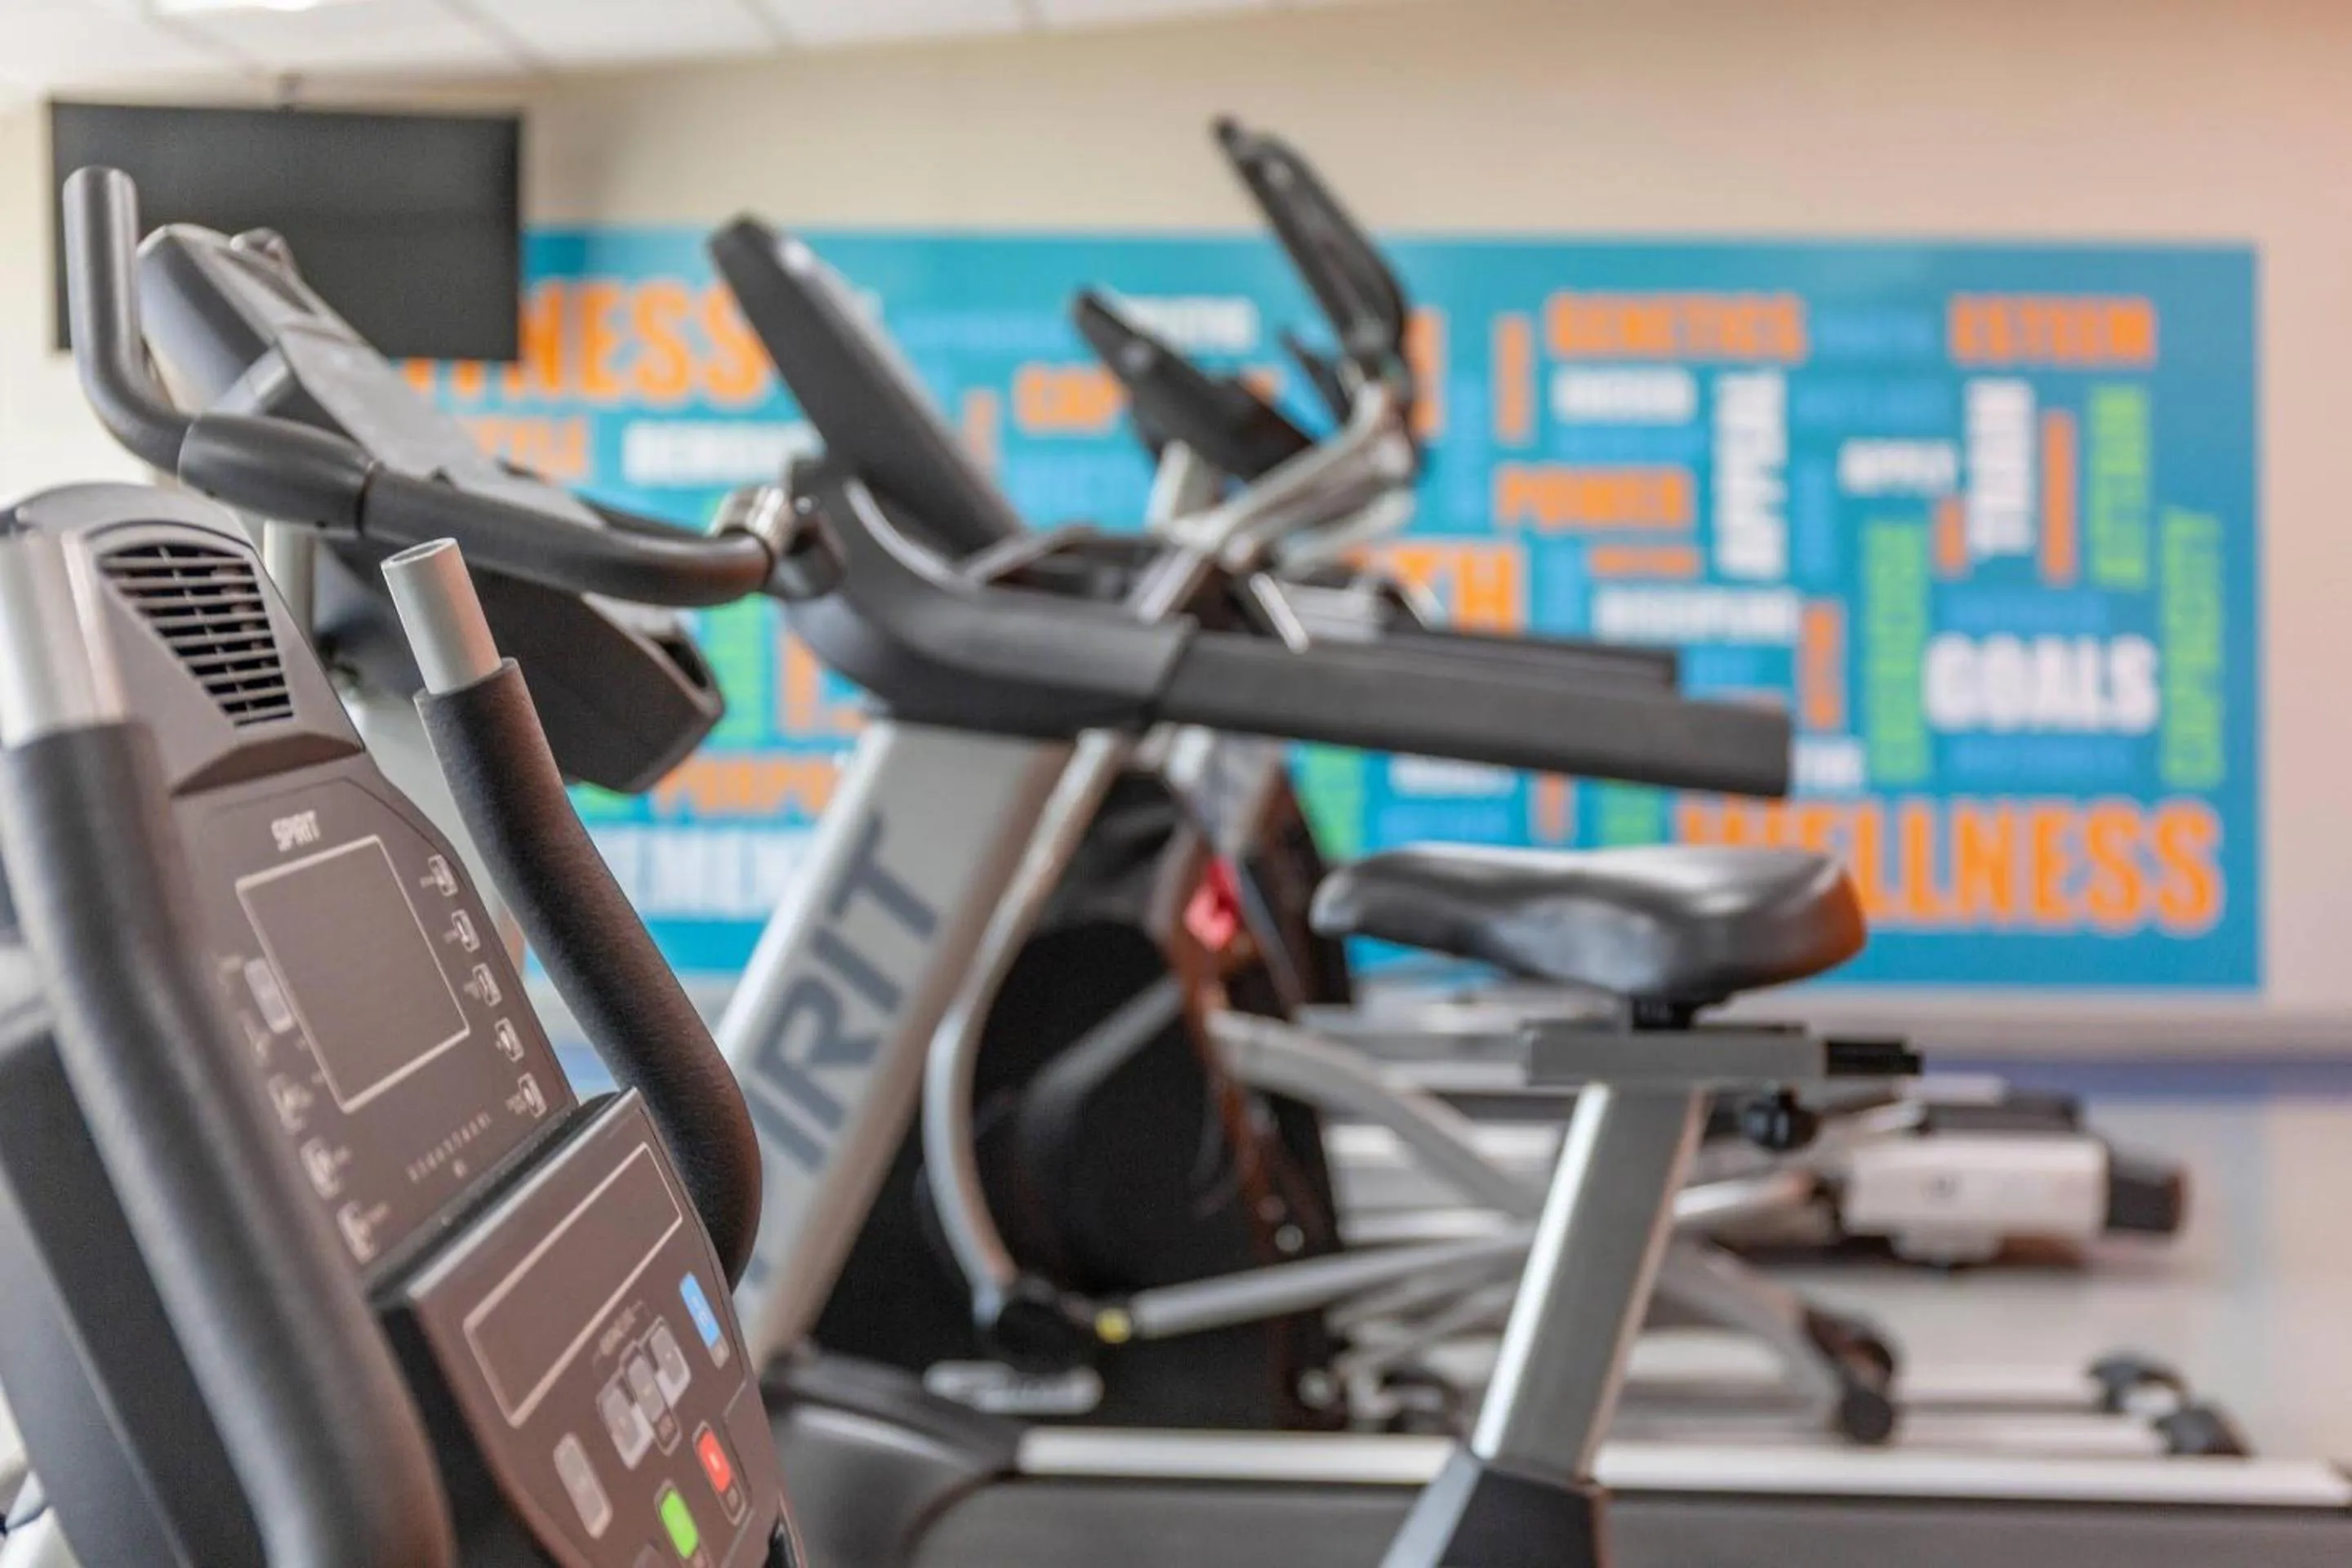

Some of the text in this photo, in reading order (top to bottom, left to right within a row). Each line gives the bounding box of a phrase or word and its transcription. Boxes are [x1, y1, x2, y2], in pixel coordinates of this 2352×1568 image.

[400, 279, 772, 406] NESS
[1926, 634, 2158, 733] GOALS
[742, 815, 939, 1176] IRIT
